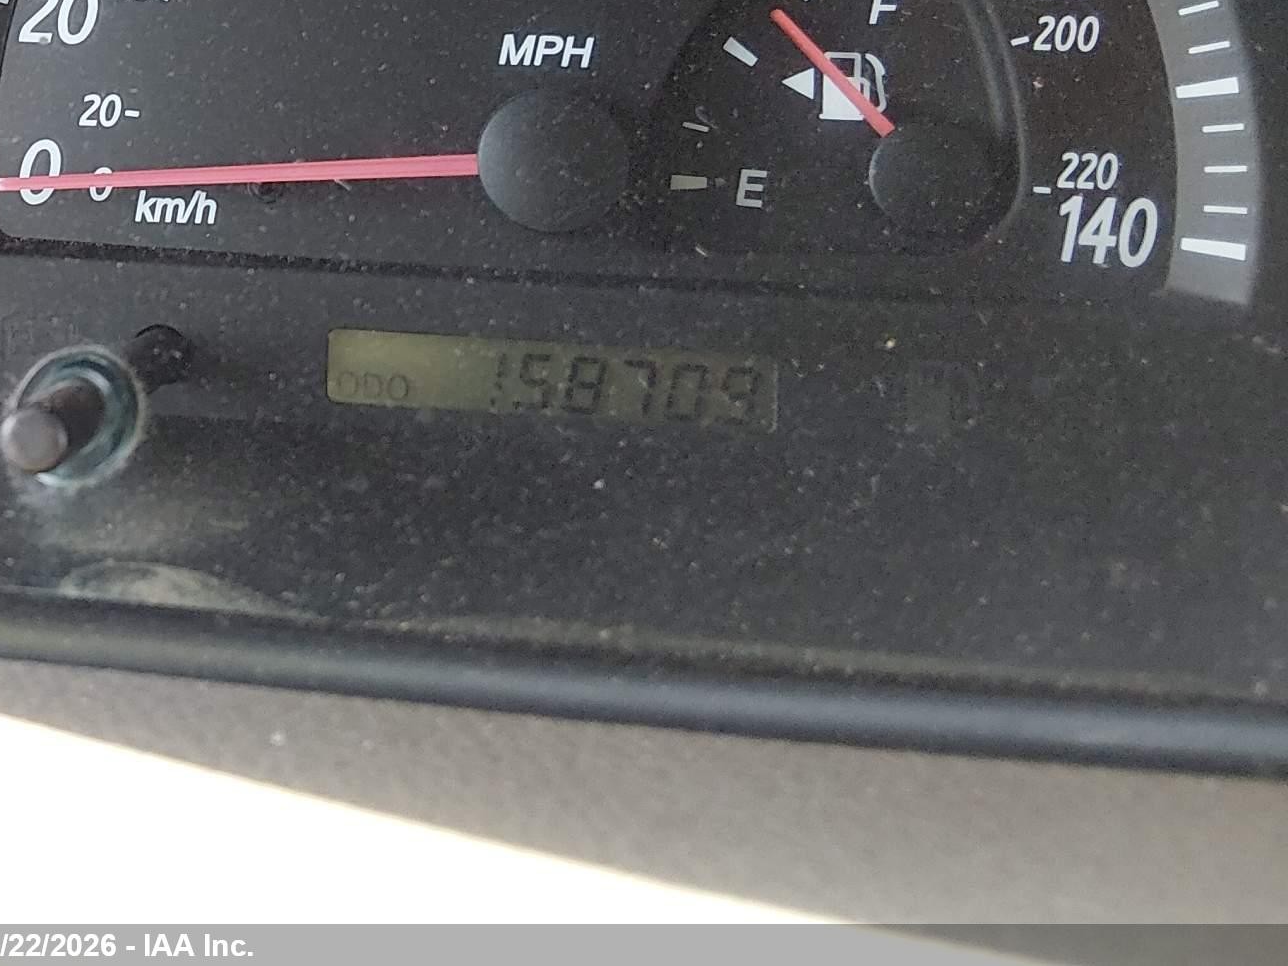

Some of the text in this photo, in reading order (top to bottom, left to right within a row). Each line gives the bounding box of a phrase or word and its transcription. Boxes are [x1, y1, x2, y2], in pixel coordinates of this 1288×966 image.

[497, 32, 596, 69] MPH
[1033, 15, 1101, 54] 200
[78, 93, 122, 128] 20
[18, 138, 63, 206] 0
[735, 168, 769, 209] E
[1056, 151, 1119, 192] 220
[134, 189, 218, 226] km/h
[1059, 195, 1159, 269] 140
[489, 352, 761, 427] 158709
